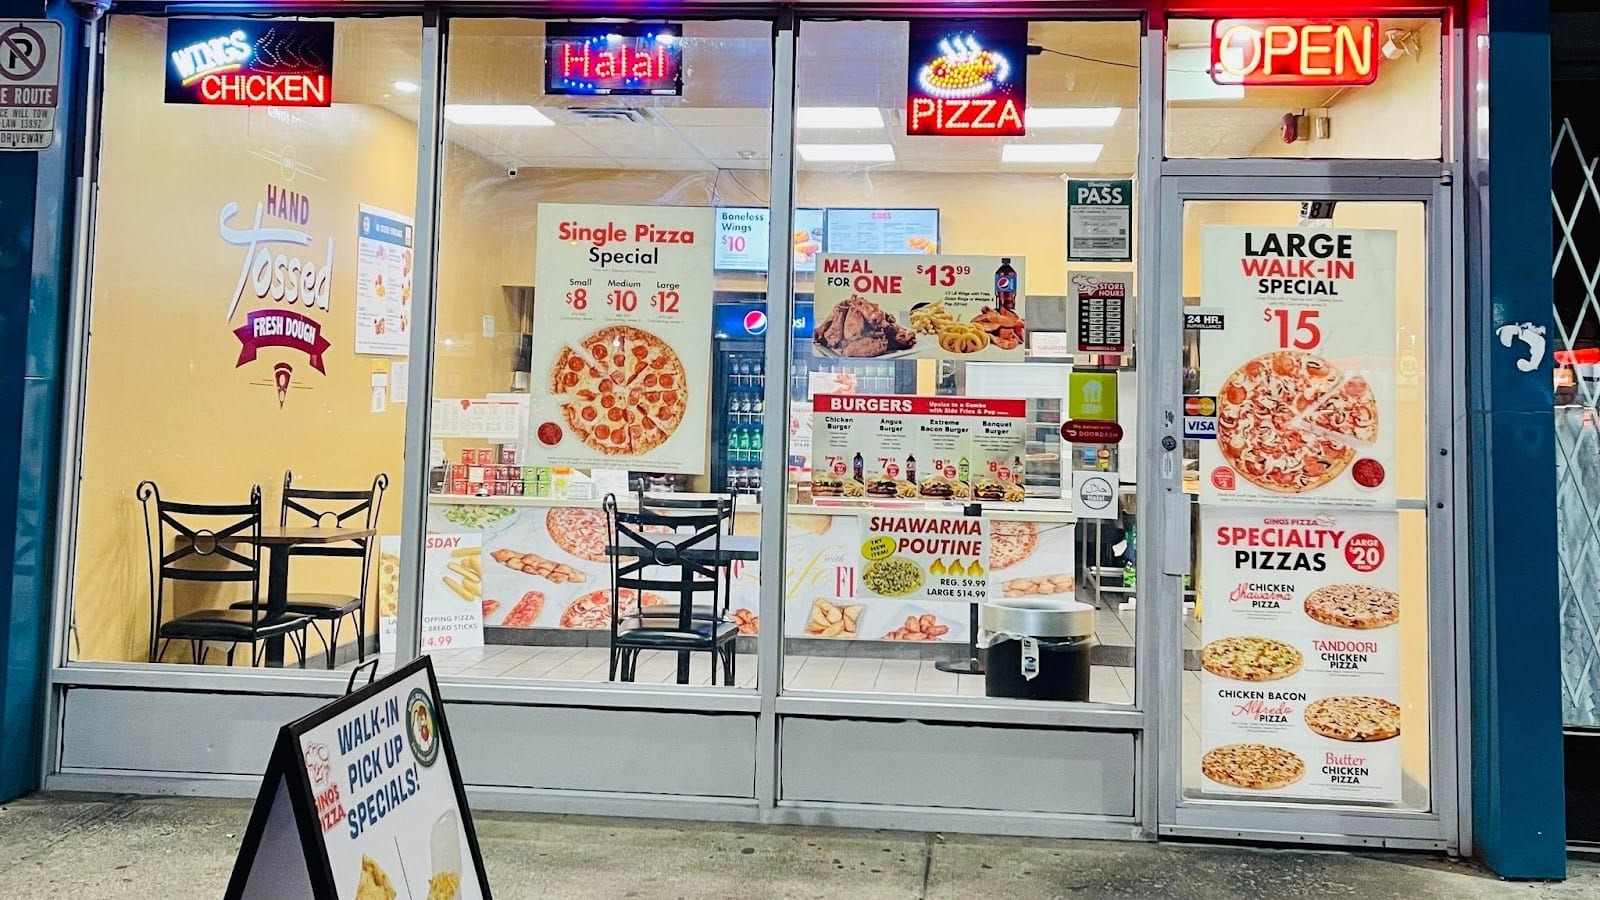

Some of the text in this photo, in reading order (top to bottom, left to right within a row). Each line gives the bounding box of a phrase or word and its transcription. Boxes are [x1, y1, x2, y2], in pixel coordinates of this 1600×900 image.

[171, 29, 251, 78] WINGS
[1218, 25, 1373, 76] OPEN
[563, 43, 665, 78] Halal
[15, 87, 52, 105] ROUTE
[201, 75, 324, 103] CHICKEN
[12, 109, 28, 118] WILL
[33, 109, 48, 118] TOW
[911, 98, 1023, 130] PIZZA
[1, 133, 44, 144] DRIVEWAY
[266, 184, 309, 225] HAND
[1077, 187, 1123, 205] PASS
[721, 212, 764, 221] Boneless
[558, 222, 695, 247] Single Pizza
[721, 222, 752, 232] Wings
[721, 235, 746, 252] $10
[1244, 232, 1353, 259] LARGE
[219, 201, 335, 325] Tossed
[588, 247, 659, 267] Special
[824, 259, 872, 274] MEAL
[1241, 258, 1355, 280] WALK-IN
[569, 278, 592, 287] Small
[607, 279, 641, 288] Medium
[656, 281, 680, 291] Large
[827, 275, 902, 294] FOR ONE
[1258, 279, 1339, 296] SPECIAL
[565, 288, 588, 310] $8
[606, 290, 638, 312] $10
[650, 291, 680, 313] $12
[1187, 315, 1201, 324] 24
[253, 316, 316, 345] FRESH DOUGH
[1263, 308, 1321, 351] $15
[831, 398, 913, 412] BURGERS
[827, 423, 851, 431] Burger
[880, 418, 902, 426] Angus
[1188, 421, 1215, 431] VISA
[869, 516, 982, 535] SHAWARMA
[1291, 518, 1318, 526] PIZZA
[426, 537, 461, 550] SDAY
[1217, 527, 1345, 549] SPECIALTY
[1350, 538, 1379, 547] LARGE
[898, 538, 982, 556] POUTINE
[1235, 550, 1327, 571] PIZZAS
[940, 578, 986, 587] REG. $9.99
[1249, 583, 1295, 593] CHICKEN
[927, 588, 986, 598] LARGE $14.99
[1229, 582, 1293, 604] Shawarma
[1252, 600, 1280, 609] PIZZA
[428, 624, 452, 632] BREAD
[1312, 640, 1378, 653] TANDOORI
[1321, 653, 1367, 662] CHICKEN
[1330, 661, 1359, 670] PIZZA
[1218, 689, 1307, 701] CHICKEN BACON
[1231, 700, 1294, 721] Alfredo
[1259, 714, 1288, 723] PIZZA
[337, 696, 400, 756] WALK-IN
[347, 752, 383, 794] PICK
[385, 733, 403, 769] UP
[1325, 752, 1366, 767] Butter
[1321, 766, 1369, 776] CHICKEN
[1331, 775, 1360, 784] PIZZA
[347, 761, 420, 840] SPECIALS!
[319, 804, 346, 832] IZZA
